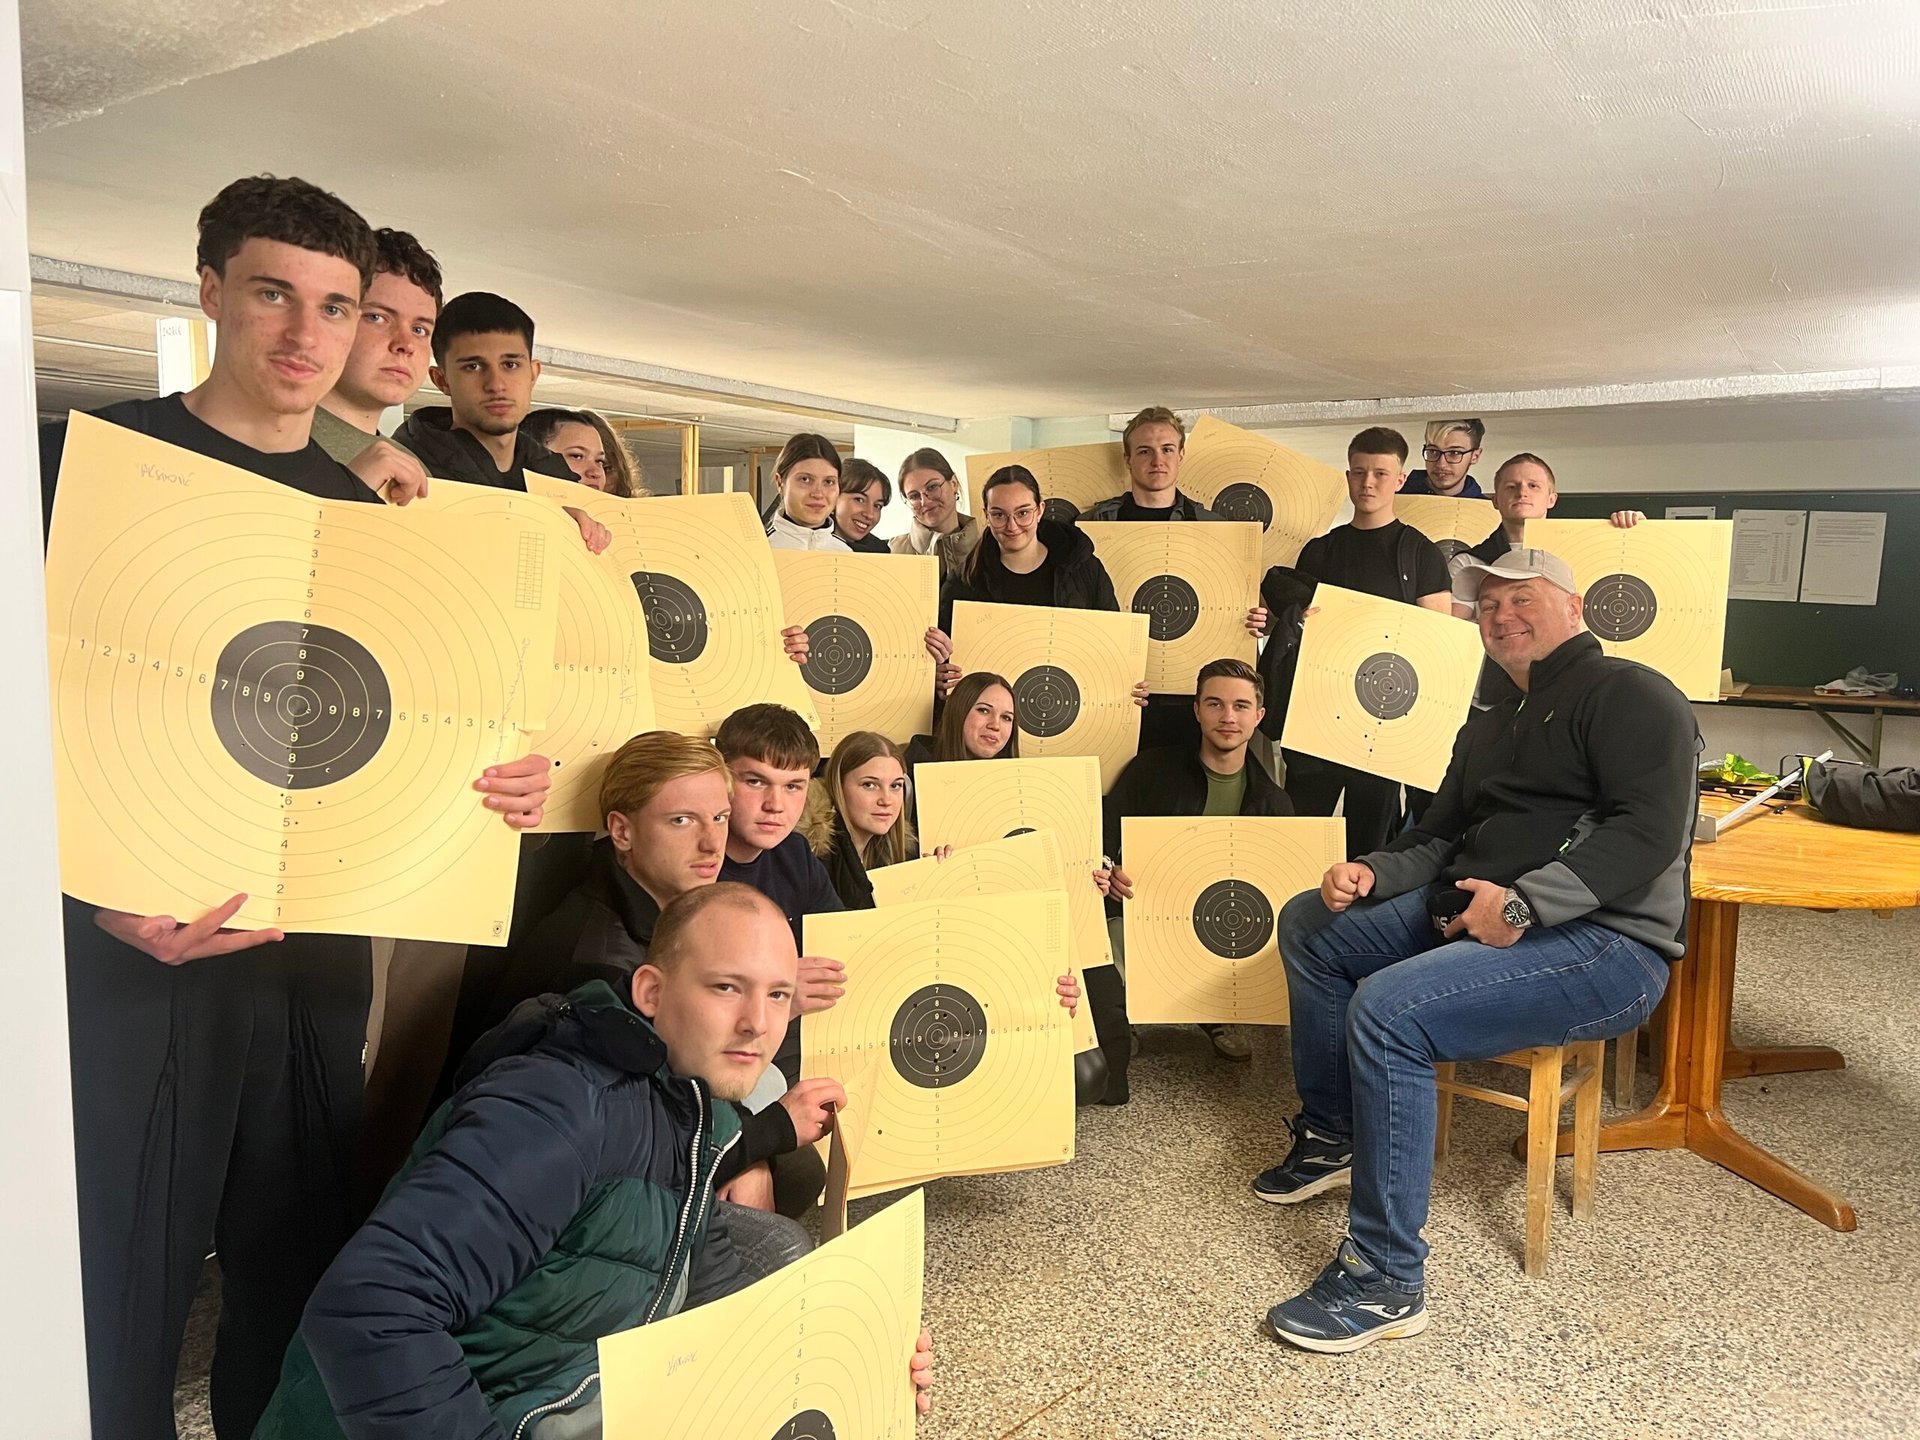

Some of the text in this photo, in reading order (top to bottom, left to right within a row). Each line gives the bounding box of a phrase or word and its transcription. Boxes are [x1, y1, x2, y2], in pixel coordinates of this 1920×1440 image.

[554, 662, 560, 671] 6
[569, 663, 574, 672] 5
[598, 666, 603, 674] 3
[612, 667, 617, 675] 2
[80, 639, 517, 731] 1 2 3 4 5 6 7 8 9 9 8 7 6 5 4 3 2 1
[276, 510, 323, 917] 1 2 3 4 5 6 7 8 9 9 8 7 6 5 4 3 2 1
[800, 1298, 806, 1310] 2
[798, 1323, 804, 1335] 3
[796, 1348, 802, 1358] 4
[794, 1372, 800, 1385] 5
[792, 1398, 798, 1410] 6
[790, 1422, 796, 1435] 7
